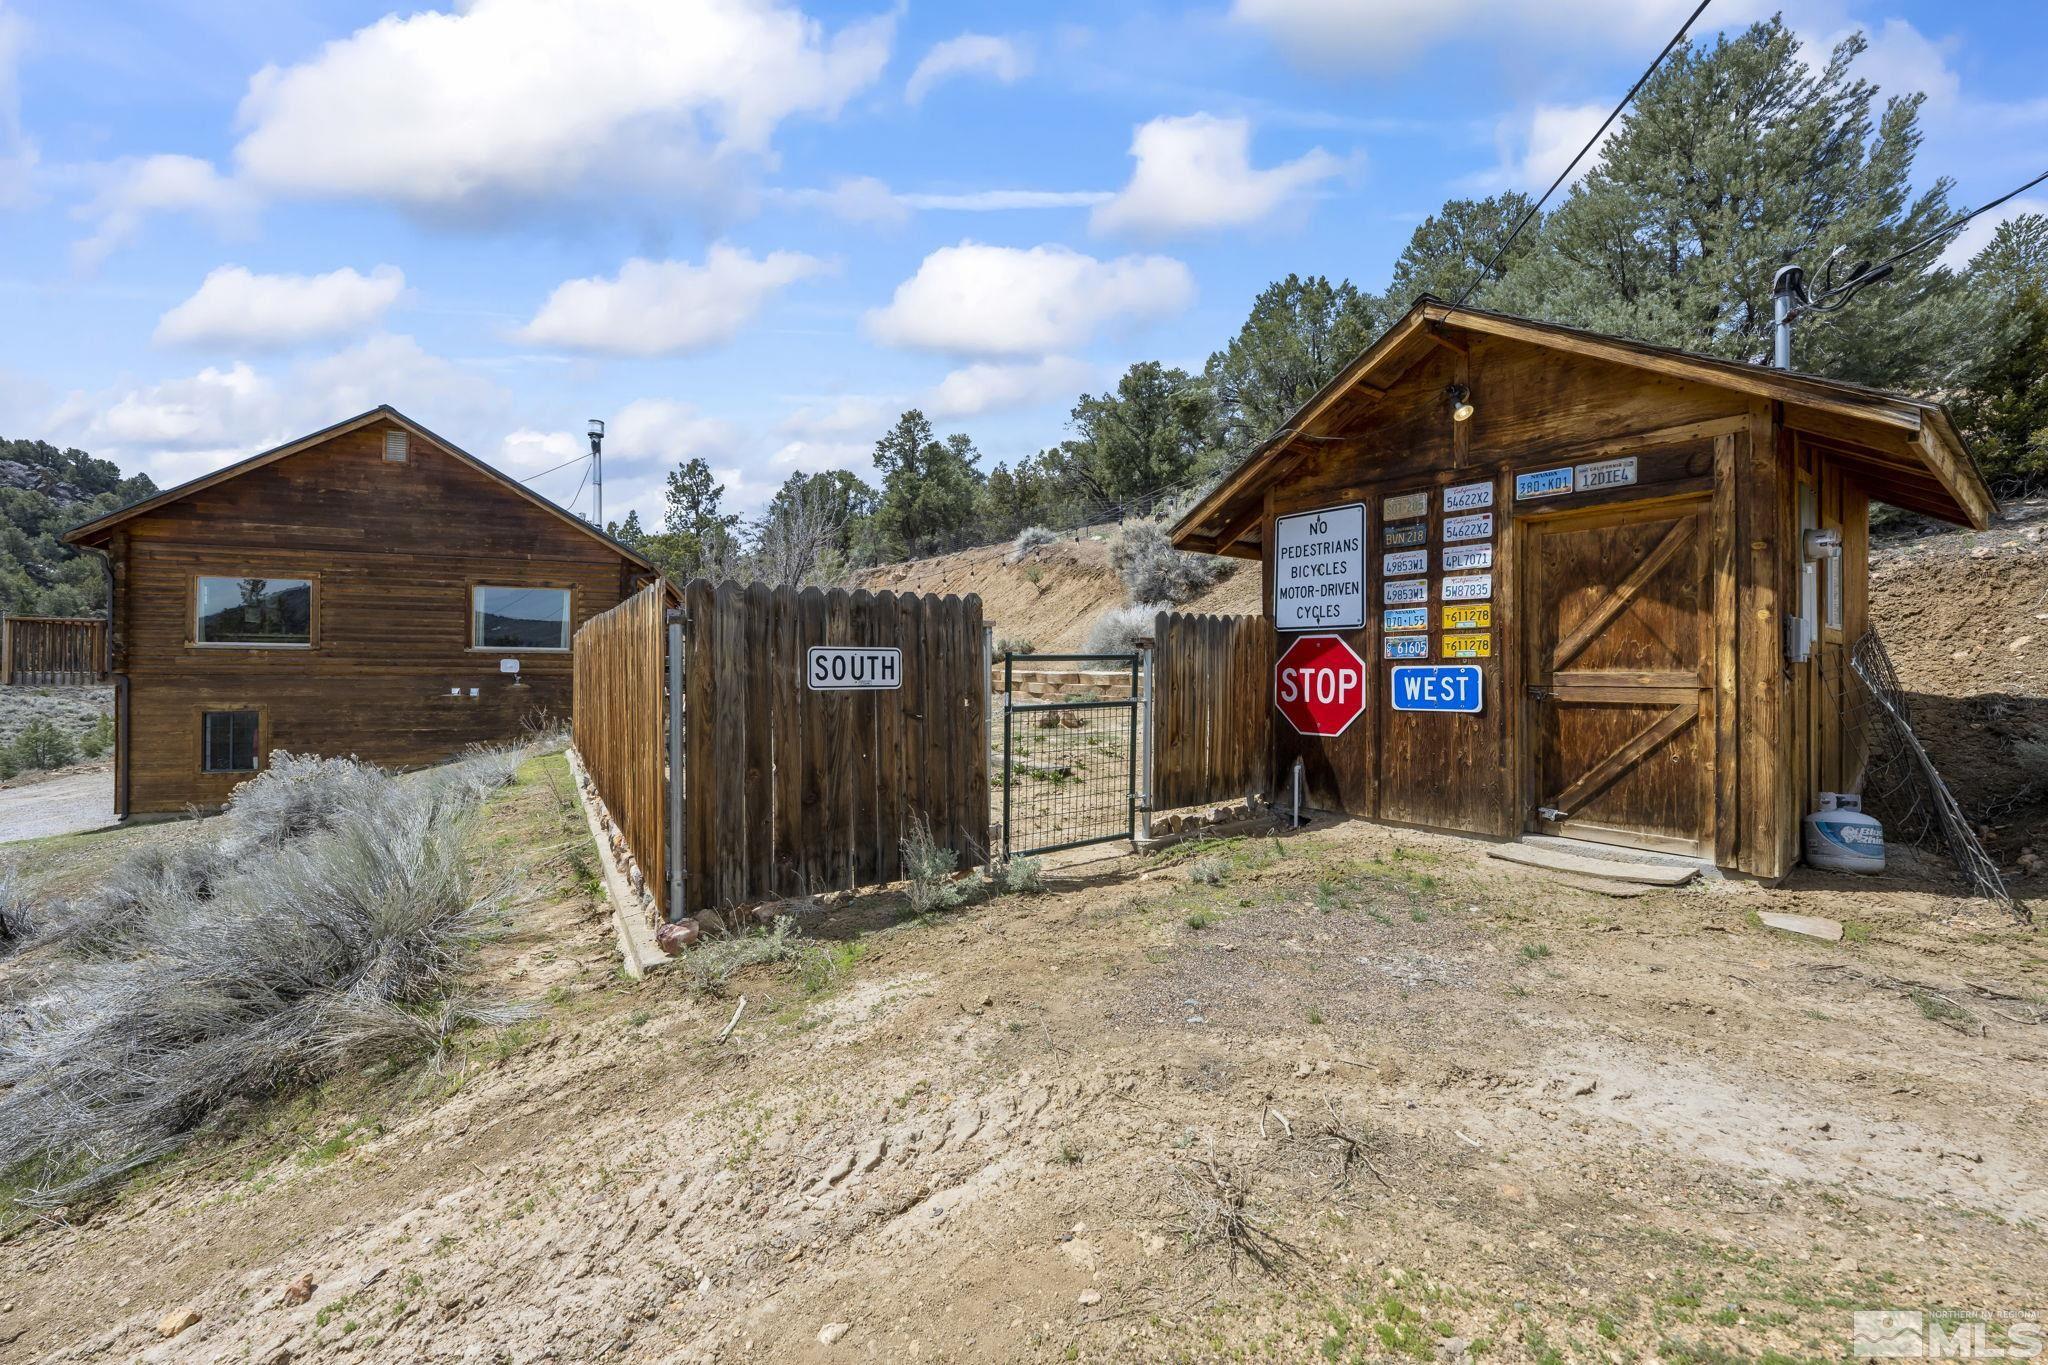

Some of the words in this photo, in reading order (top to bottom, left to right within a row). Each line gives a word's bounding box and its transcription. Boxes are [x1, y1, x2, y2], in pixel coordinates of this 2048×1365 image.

[1453, 486, 1481, 495] California
[1447, 492, 1489, 508] 54622X2
[1309, 521, 1328, 535] NO
[1453, 517, 1480, 526] California
[1407, 530, 1424, 543] 218
[1446, 523, 1489, 538] 54622X2
[1281, 538, 1359, 559] PEDESTRIANS
[1386, 559, 1424, 574] 49853W1
[1446, 553, 1488, 568] 4PL7071
[1291, 561, 1347, 579] BICYCLES
[1279, 581, 1360, 600] MOTOR-DRIVEN
[1386, 588, 1425, 601] 49853W1
[1445, 584, 1488, 598] 5W87835
[1296, 604, 1341, 619] CYCLES
[1397, 641, 1427, 654] 61605
[815, 655, 894, 681] SOUTH
[1280, 667, 1358, 704] STOP
[1404, 676, 1468, 701] WEST
[1857, 836, 1885, 845] Rhin
